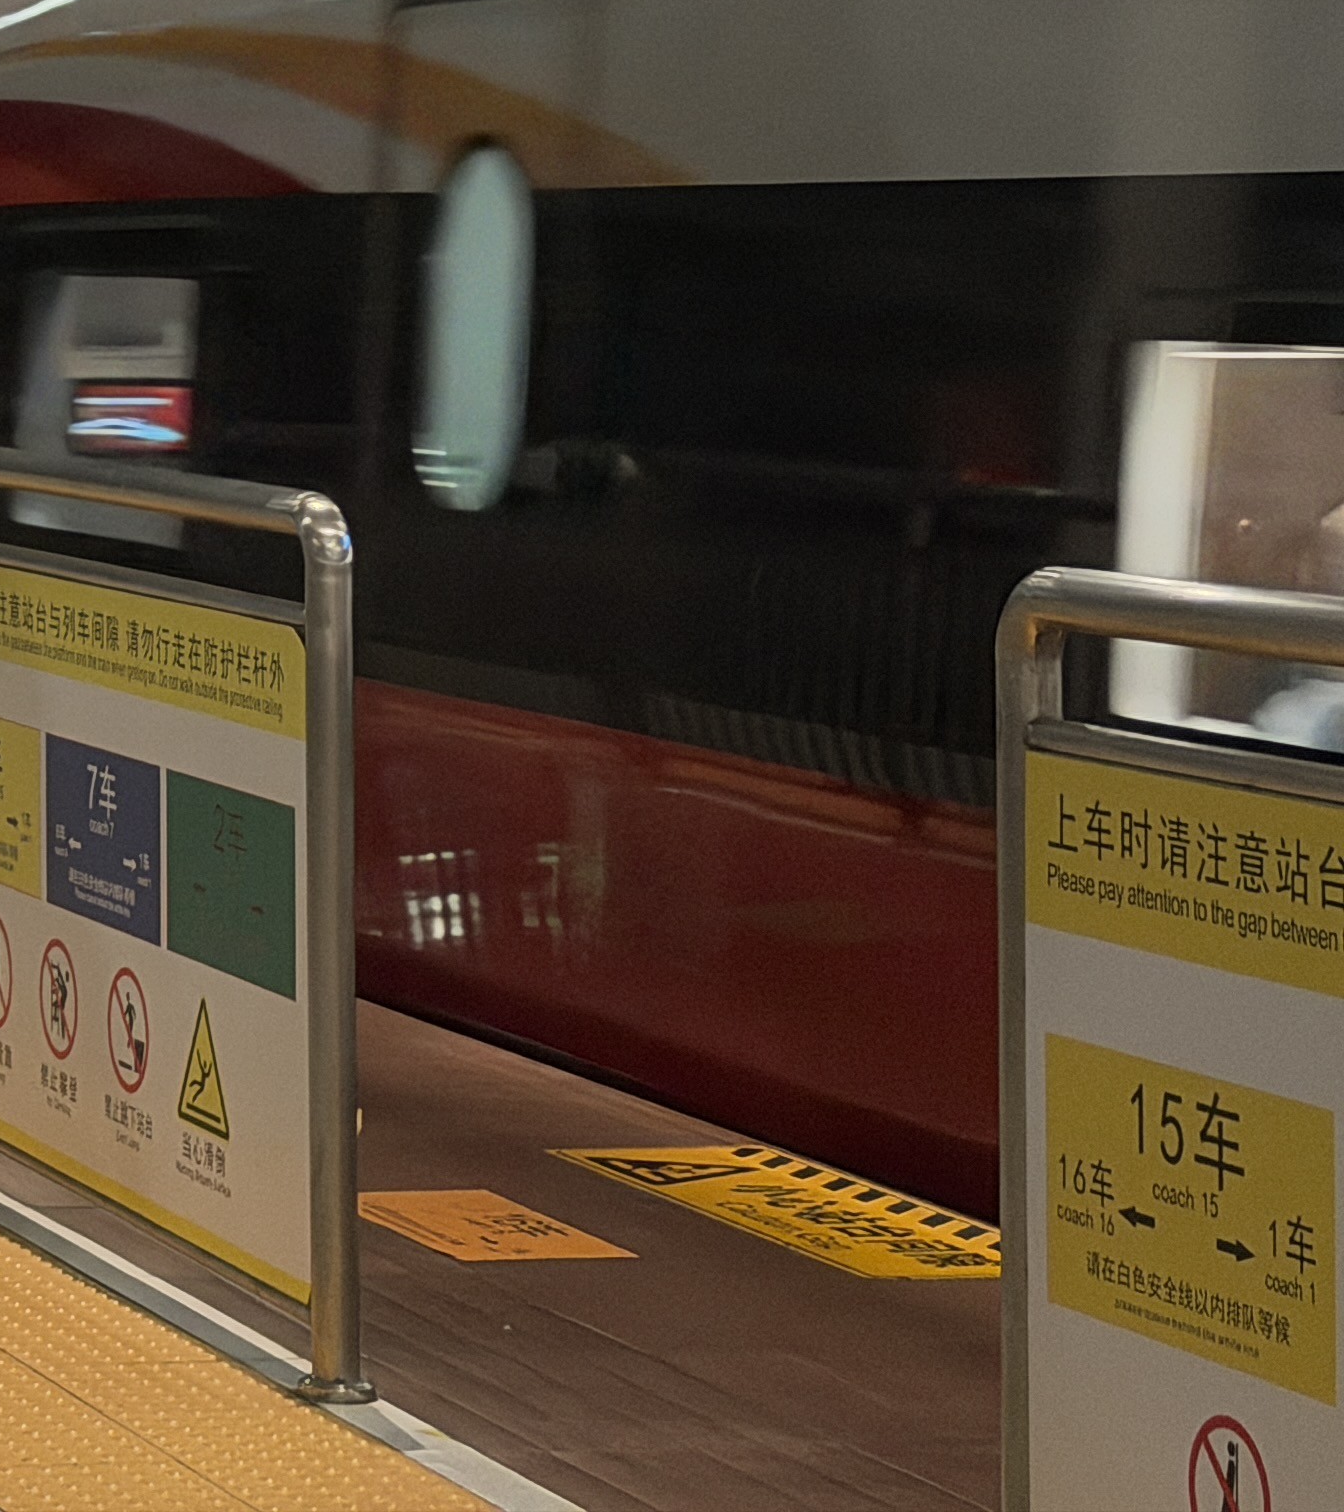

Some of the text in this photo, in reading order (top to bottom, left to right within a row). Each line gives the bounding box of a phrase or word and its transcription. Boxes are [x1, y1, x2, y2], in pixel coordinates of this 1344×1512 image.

[126, 618, 286, 694] 请勿行走在防护栏杆外
[86, 764, 117, 821] 7车
[1047, 792, 1344, 913] 上车时请注意站台
[1047, 862, 1339, 952] Please pay attention to the gap between
[1130, 1083, 1246, 1192] 15车
[1058, 1153, 1115, 1208] 16车
[1152, 1182, 1220, 1219] coach 15
[1056, 1204, 1116, 1237] coach 16
[1268, 1215, 1317, 1274] 1车
[1086, 1250, 1291, 1346] 请在白色安全线以内排队等候
[1265, 1273, 1316, 1305] coach 1
